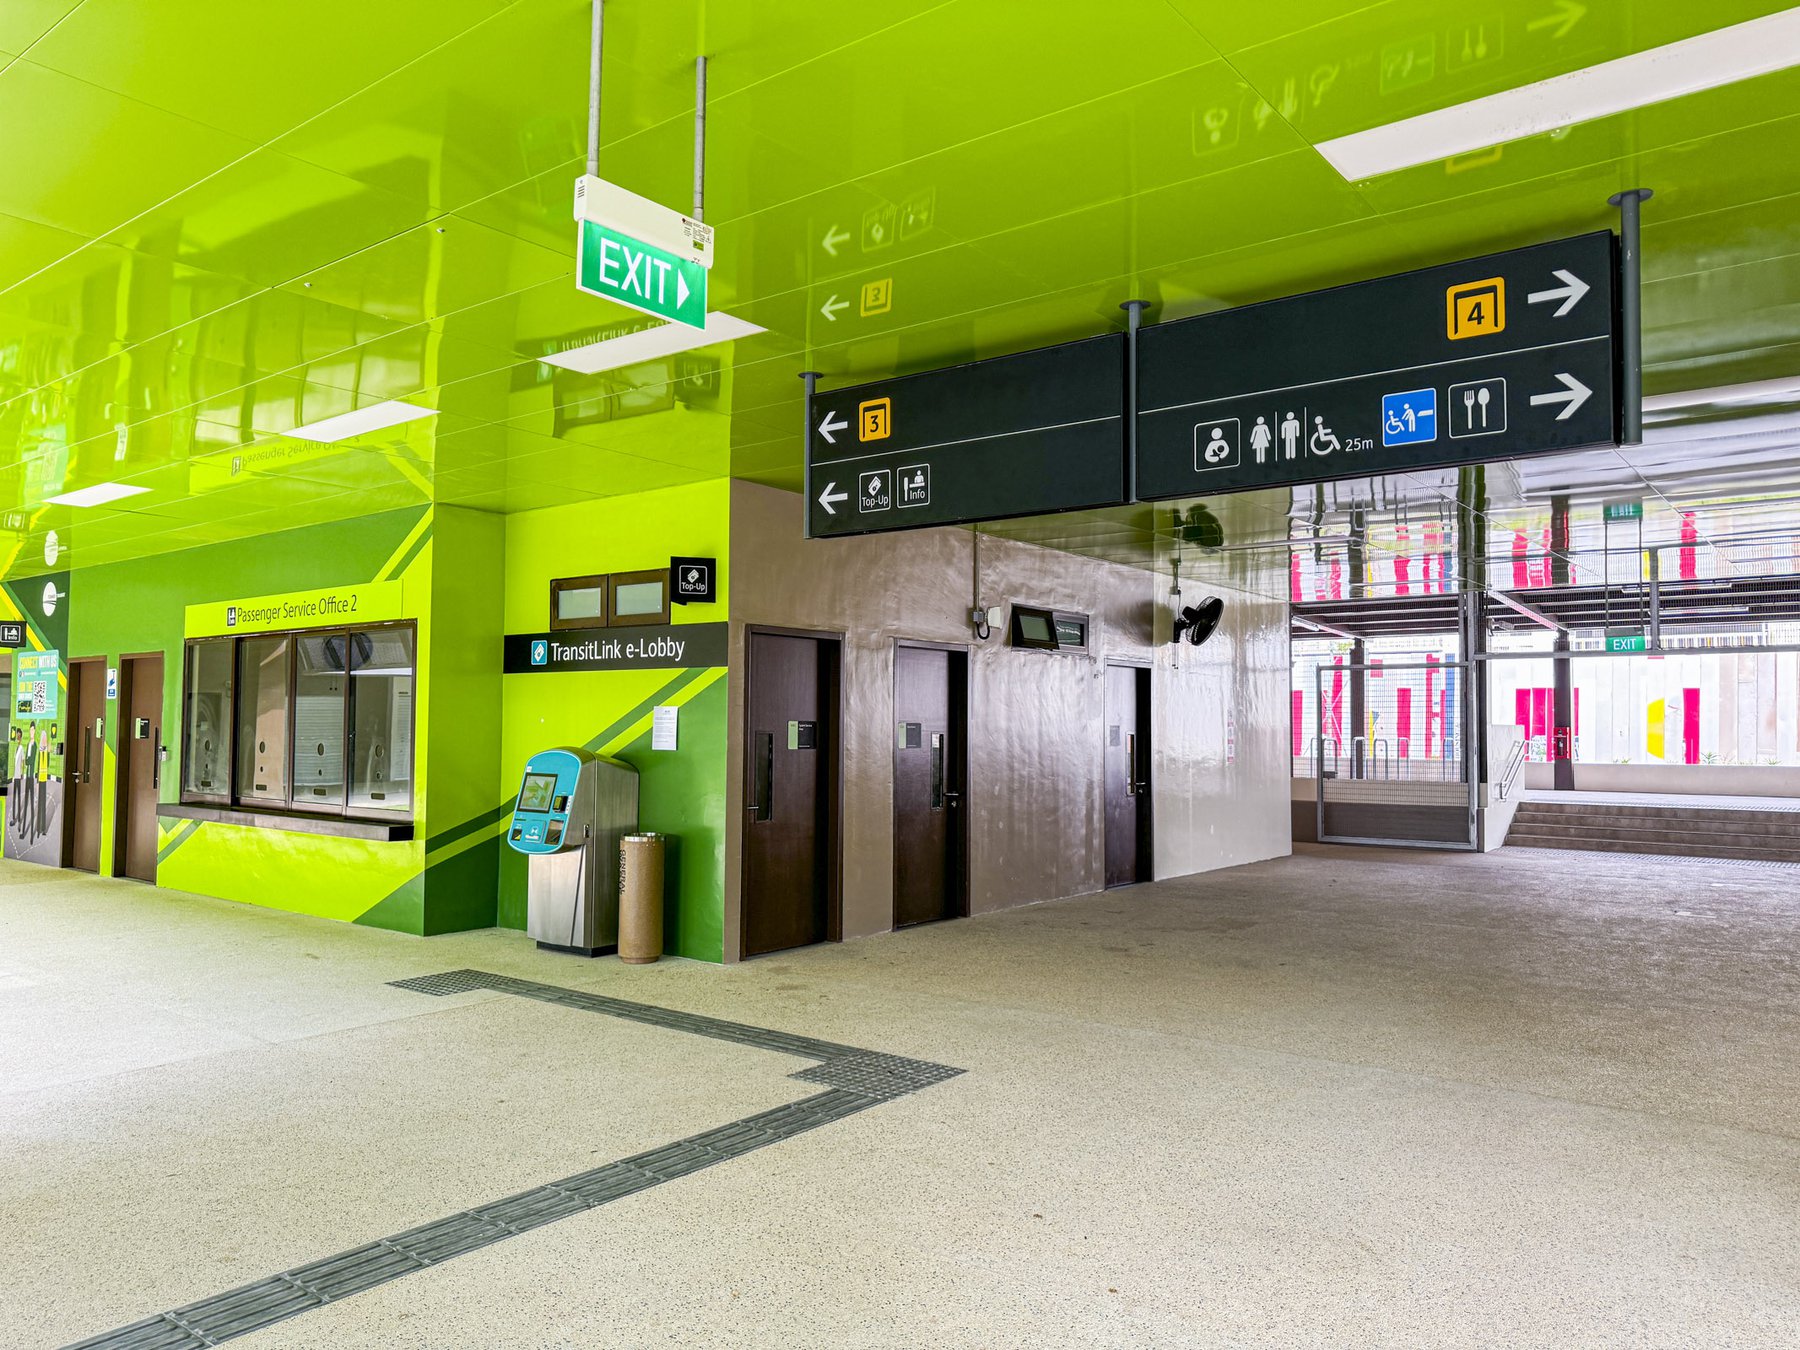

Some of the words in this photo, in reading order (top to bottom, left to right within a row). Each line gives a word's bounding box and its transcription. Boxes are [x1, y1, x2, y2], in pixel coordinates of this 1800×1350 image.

[599, 237, 672, 305] EXIT
[1467, 302, 1485, 325] 4
[869, 414, 879, 433] 3
[1345, 436, 1374, 452] 25m
[861, 495, 889, 509] Top-Up
[908, 488, 926, 500] Info
[680, 581, 706, 592] Top-Up
[237, 607, 281, 624] Passenger
[283, 600, 317, 618] Service
[318, 596, 349, 613] Office
[350, 594, 357, 612] 2
[550, 638, 622, 661] TransitLink
[626, 636, 685, 661] e-Lobby
[1613, 638, 1637, 651] EXIT
